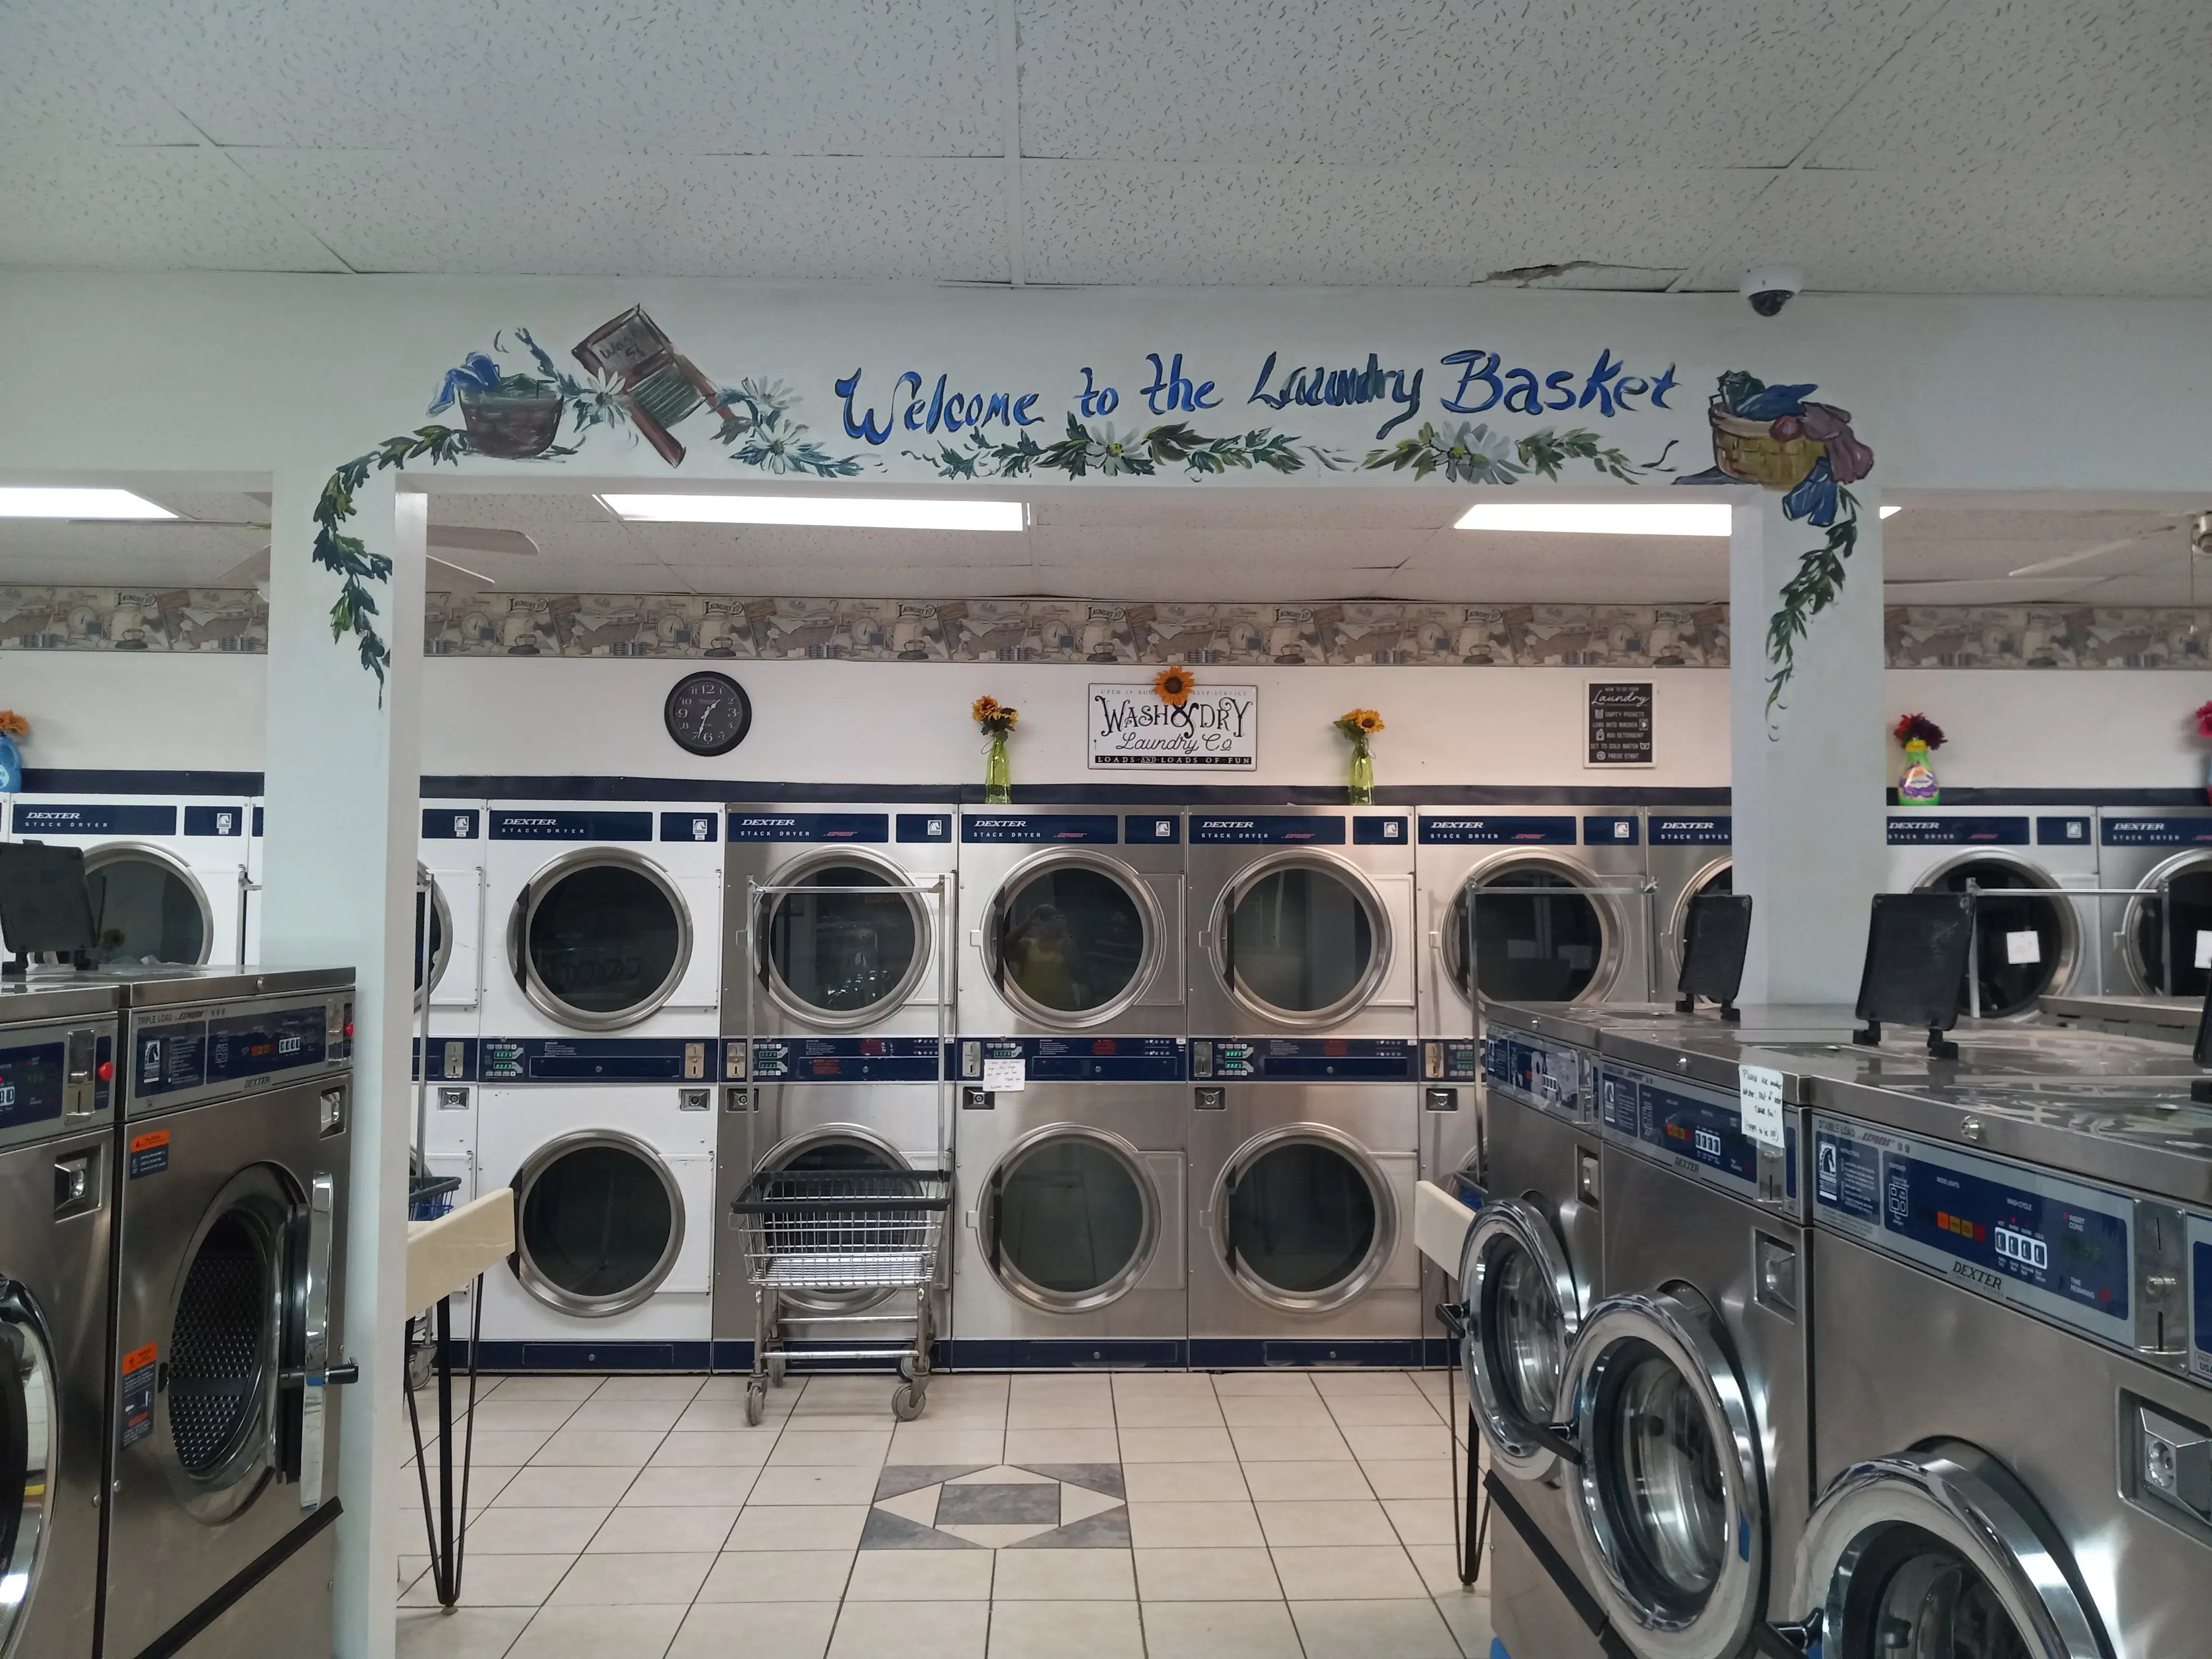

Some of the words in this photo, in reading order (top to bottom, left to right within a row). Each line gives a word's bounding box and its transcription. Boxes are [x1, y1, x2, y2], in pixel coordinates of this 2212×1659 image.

[835, 367, 1044, 445] Welcome
[1073, 367, 1118, 418] to
[1141, 353, 1223, 415] the
[1247, 351, 1423, 440] Laundry
[1441, 348, 1681, 418] Basket
[702, 685, 715, 694] 12
[1591, 689, 1650, 707] Laundry
[678, 709, 688, 718] 9
[727, 708, 737, 717] 3
[1095, 696, 1168, 736] WASH
[1200, 697, 1253, 737] DRY
[703, 733, 713, 742] 6
[1116, 732, 1199, 754] Laundry
[138, 1015, 156, 1024] TRIPLE
[157, 1013, 172, 1022] LOAD
[244, 1076, 270, 1088] DEXTER
[1841, 1126, 1856, 1138] LOAD
[1674, 1156, 1700, 1174] DEXTER
[1952, 1261, 2003, 1290] DEXTER
